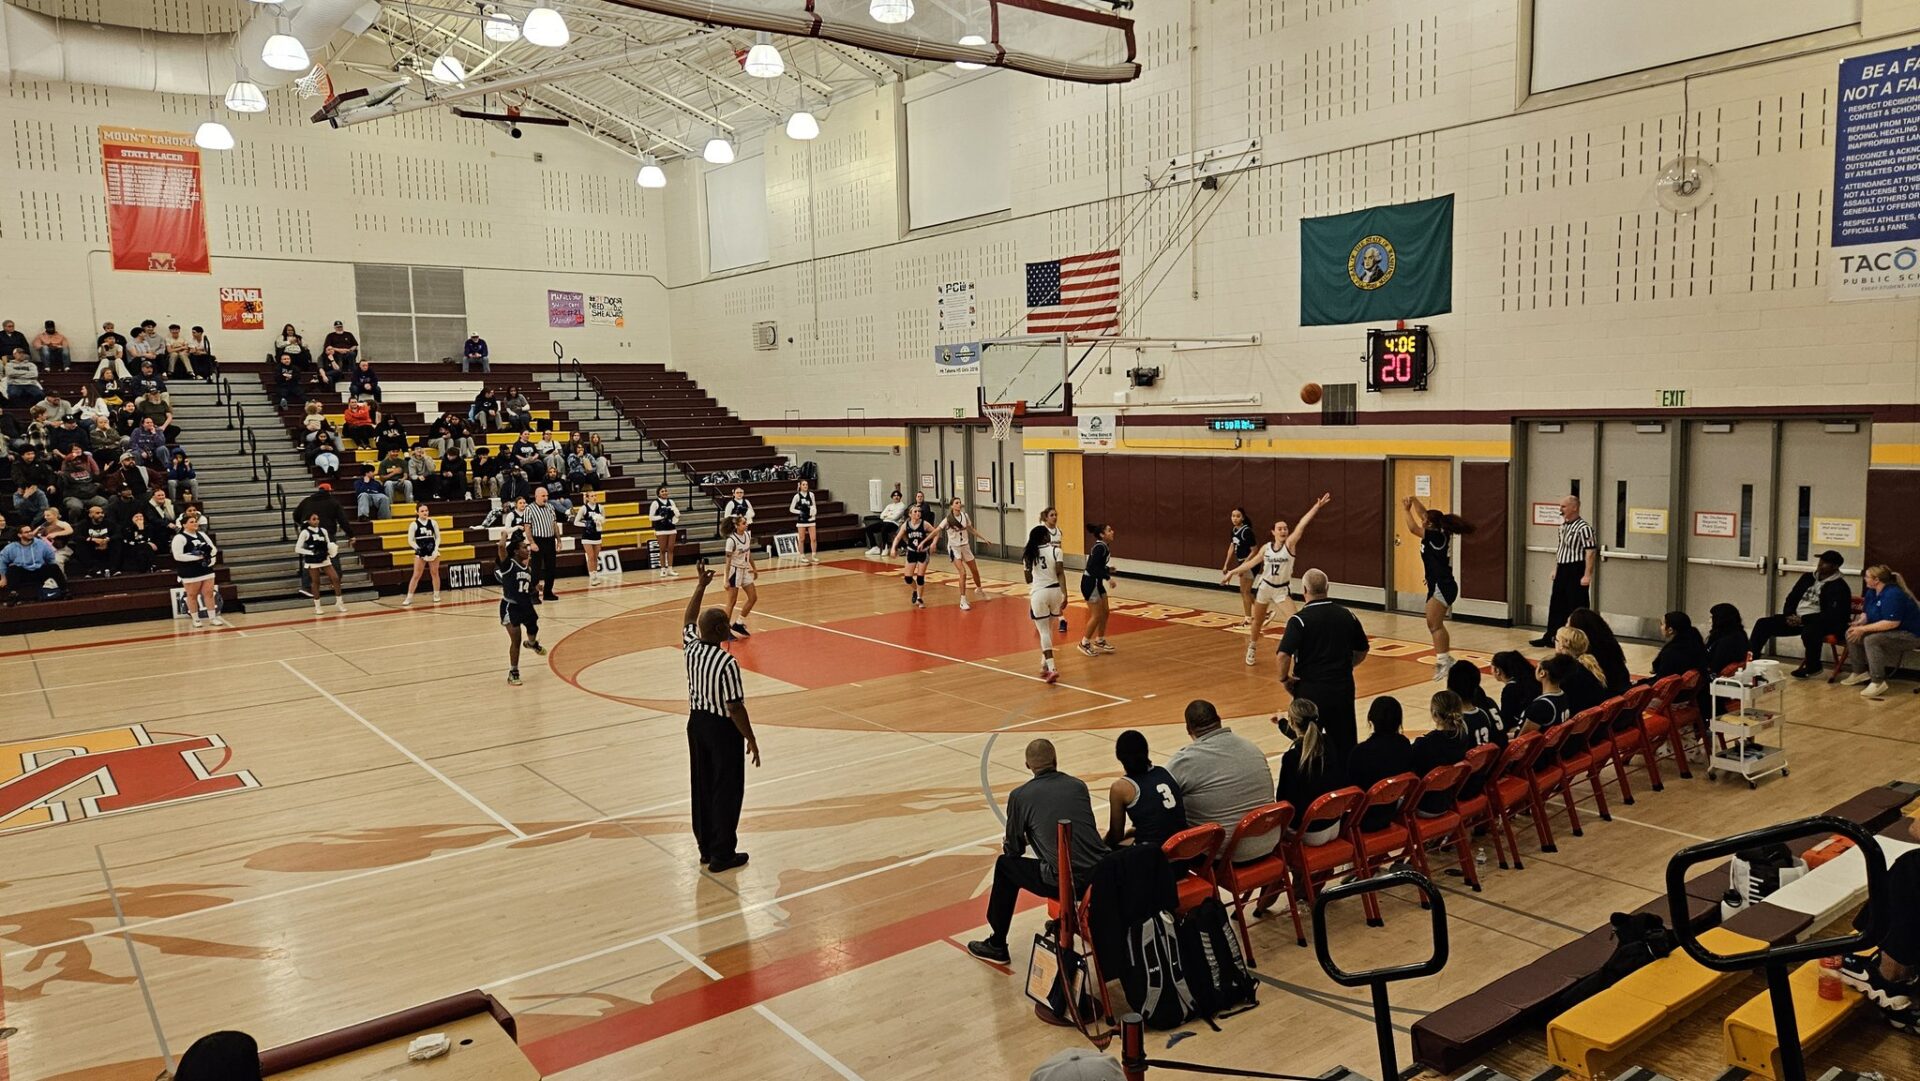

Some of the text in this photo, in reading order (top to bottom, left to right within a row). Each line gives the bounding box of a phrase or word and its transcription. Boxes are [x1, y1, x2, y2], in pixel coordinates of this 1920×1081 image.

[1862, 63, 1885, 80] BE
[1888, 61, 1899, 76] A
[1843, 84, 1879, 102] NOT
[1880, 81, 1892, 96] A
[1848, 102, 1881, 112] RESPECT
[1849, 110, 1882, 121] CONTEST
[1847, 123, 1878, 133] REFRAIN
[1880, 119, 1901, 128] FROM
[1880, 126, 1918, 136] HECKLING
[104, 130, 147, 144] MOUNT
[1848, 136, 1905, 150] INAPPROPRIATE
[121, 149, 148, 159] STATE
[1846, 151, 1888, 162] RECOGNIZE
[1845, 158, 1895, 170] OUTSTANDING
[1856, 167, 1892, 177] ATHLETES
[1844, 179, 1892, 190] ATTENDANCE
[1844, 191, 1858, 199] NOT
[1866, 188, 1897, 196] LICENSE
[1844, 198, 1876, 207] ASSAULT
[1877, 194, 1907, 204] OTHERS
[1843, 205, 1885, 216] GENERALLY
[1843, 218, 1876, 227] RESPECT
[1842, 225, 1879, 236] OFFICIALS
[1887, 223, 1908, 231] FANS.
[1844, 276, 1890, 285] PUBLIC
[1382, 354, 1410, 382] 20
[1662, 390, 1685, 406] EXIT
[776, 536, 798, 554] HEY
[450, 564, 482, 588] GET HYPE
[1271, 564, 1280, 576] 12
[518, 580, 529, 593] 14
[1490, 708, 1503, 730] 5
[1475, 727, 1489, 745] 13
[1156, 783, 1176, 809] 3
